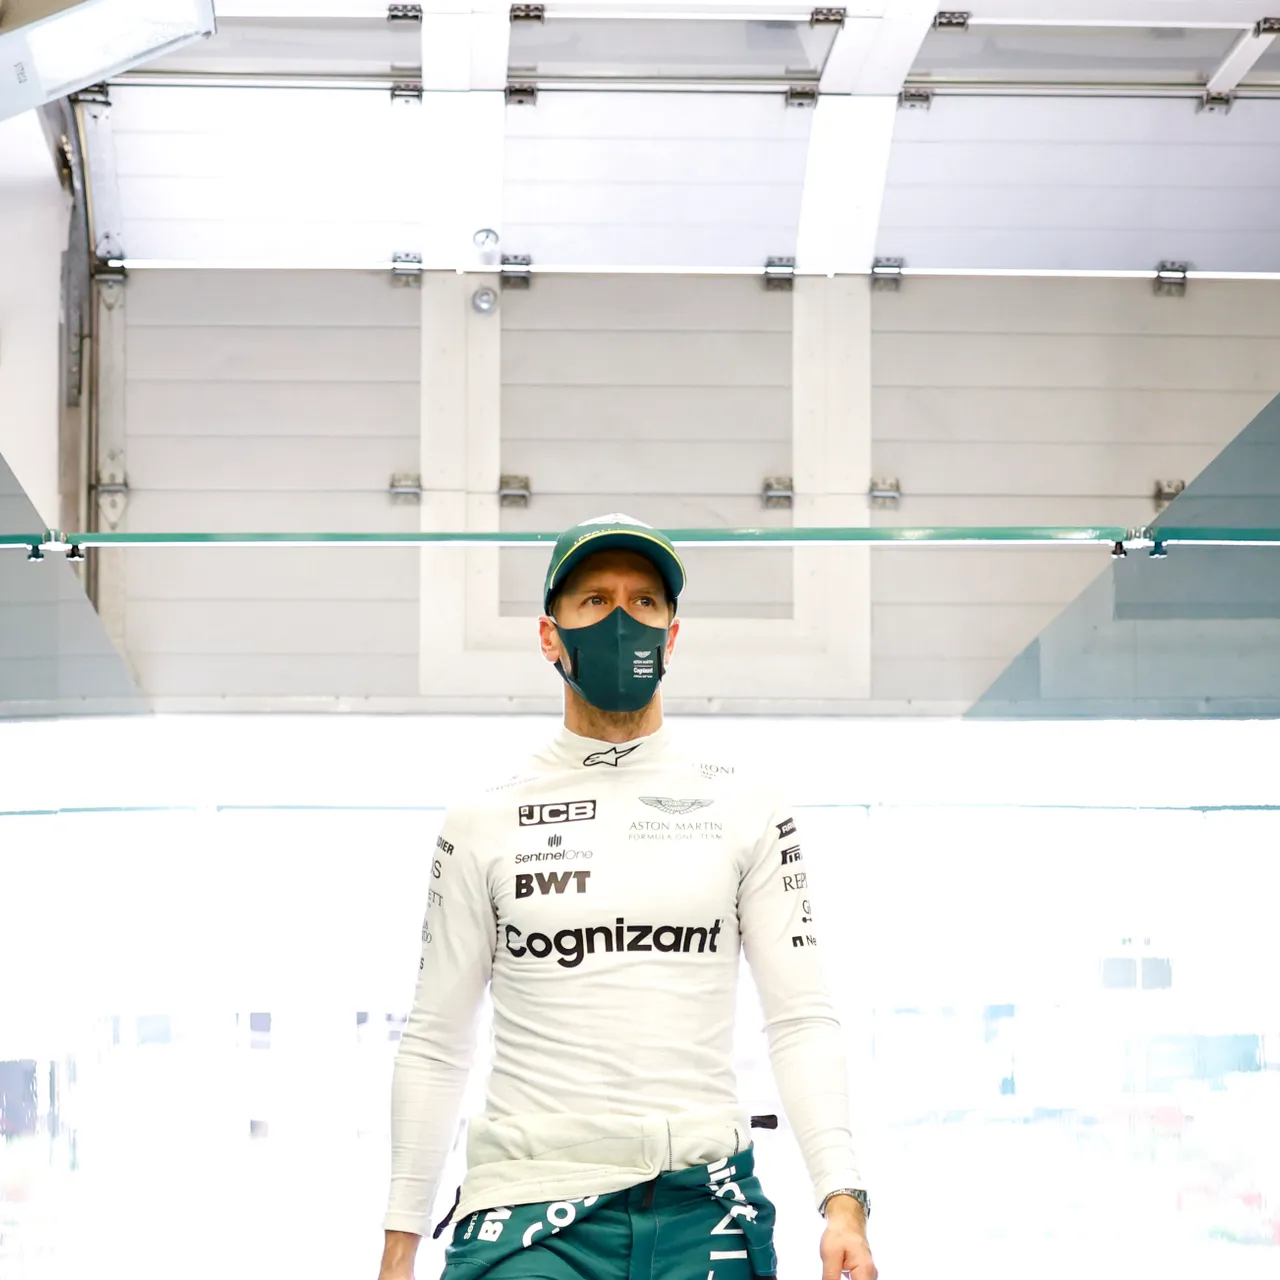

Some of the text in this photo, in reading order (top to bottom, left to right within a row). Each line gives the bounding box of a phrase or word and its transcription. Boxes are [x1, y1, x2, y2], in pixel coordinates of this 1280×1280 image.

[519, 800, 596, 826] JCB
[629, 821, 723, 831] ASTON MARTIN
[628, 833, 672, 841] FORMULA
[515, 849, 594, 865] SentinelOne
[515, 870, 591, 899] BWT
[505, 917, 722, 968] Cognizant
